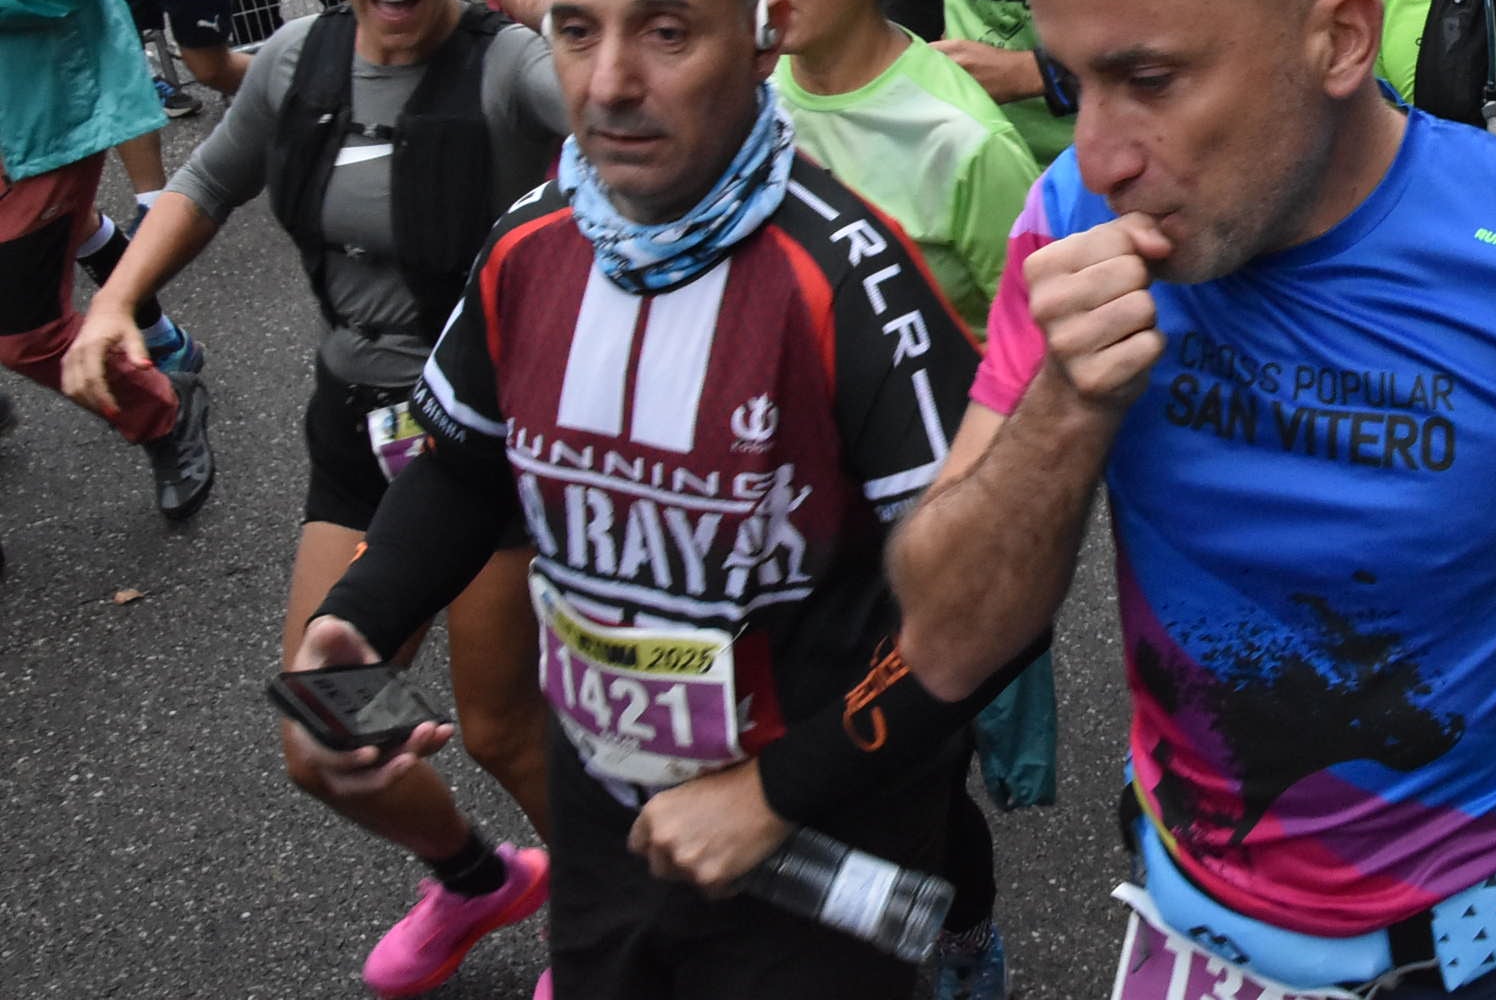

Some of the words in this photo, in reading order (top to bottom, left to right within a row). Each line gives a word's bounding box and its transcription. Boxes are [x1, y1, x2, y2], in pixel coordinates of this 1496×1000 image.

[829, 218, 932, 369] RLR
[1180, 331, 1283, 394] CROSS
[1293, 364, 1456, 412] POPULAR
[1165, 372, 1258, 444] SAN
[1274, 399, 1457, 472] VITERO
[556, 645, 694, 749] 1421
[647, 644, 718, 675] 2025
